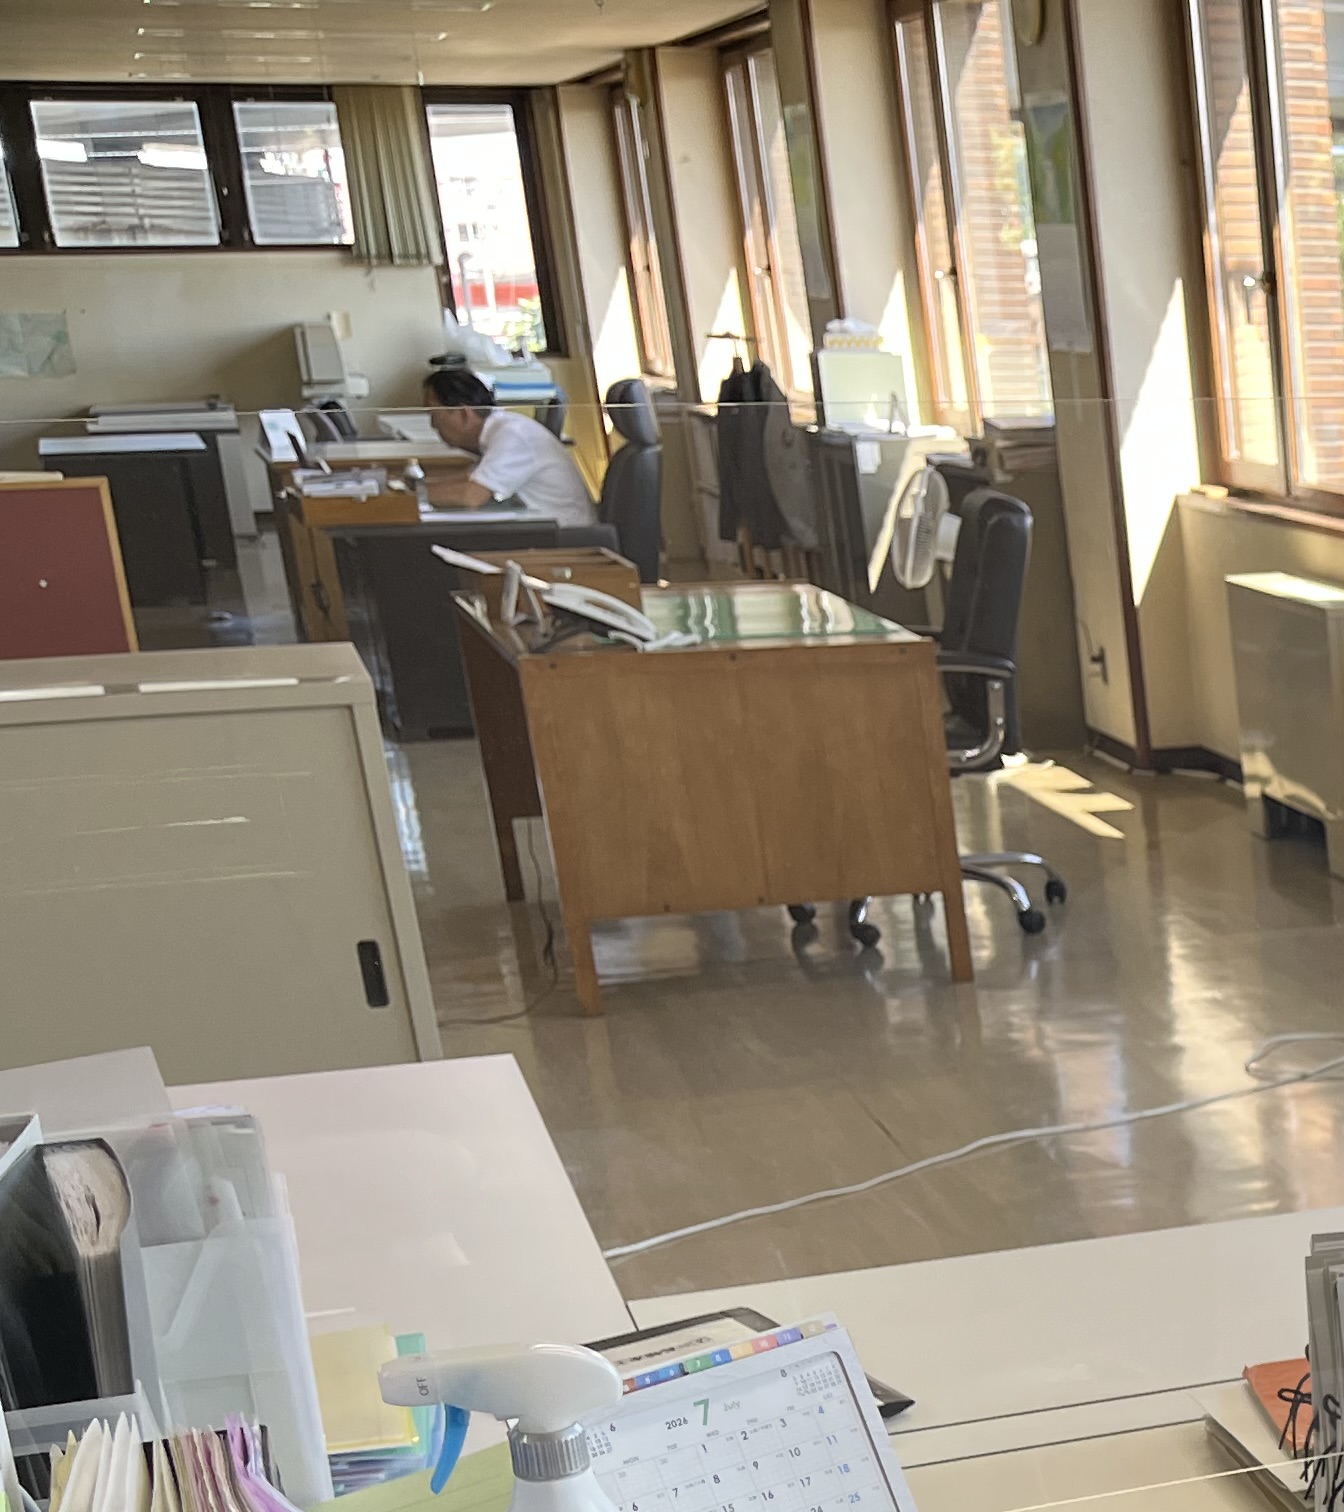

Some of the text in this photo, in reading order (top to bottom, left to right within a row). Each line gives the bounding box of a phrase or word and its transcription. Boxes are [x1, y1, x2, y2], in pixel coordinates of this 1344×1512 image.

[780, 1369, 787, 1377] 8
[416, 1377, 429, 1396] OFF
[693, 1398, 740, 1426] 7 July
[780, 1405, 824, 1428] 3 4
[610, 1423, 616, 1432] 6
[665, 1417, 688, 1430] 2026
[702, 1431, 748, 1453] 1 2
[789, 1435, 839, 1458] 10 11
[632, 1461, 758, 1512] 6 7 8 9
[762, 1464, 850, 1501] 16 17 18
[849, 1493, 861, 1504] 25
